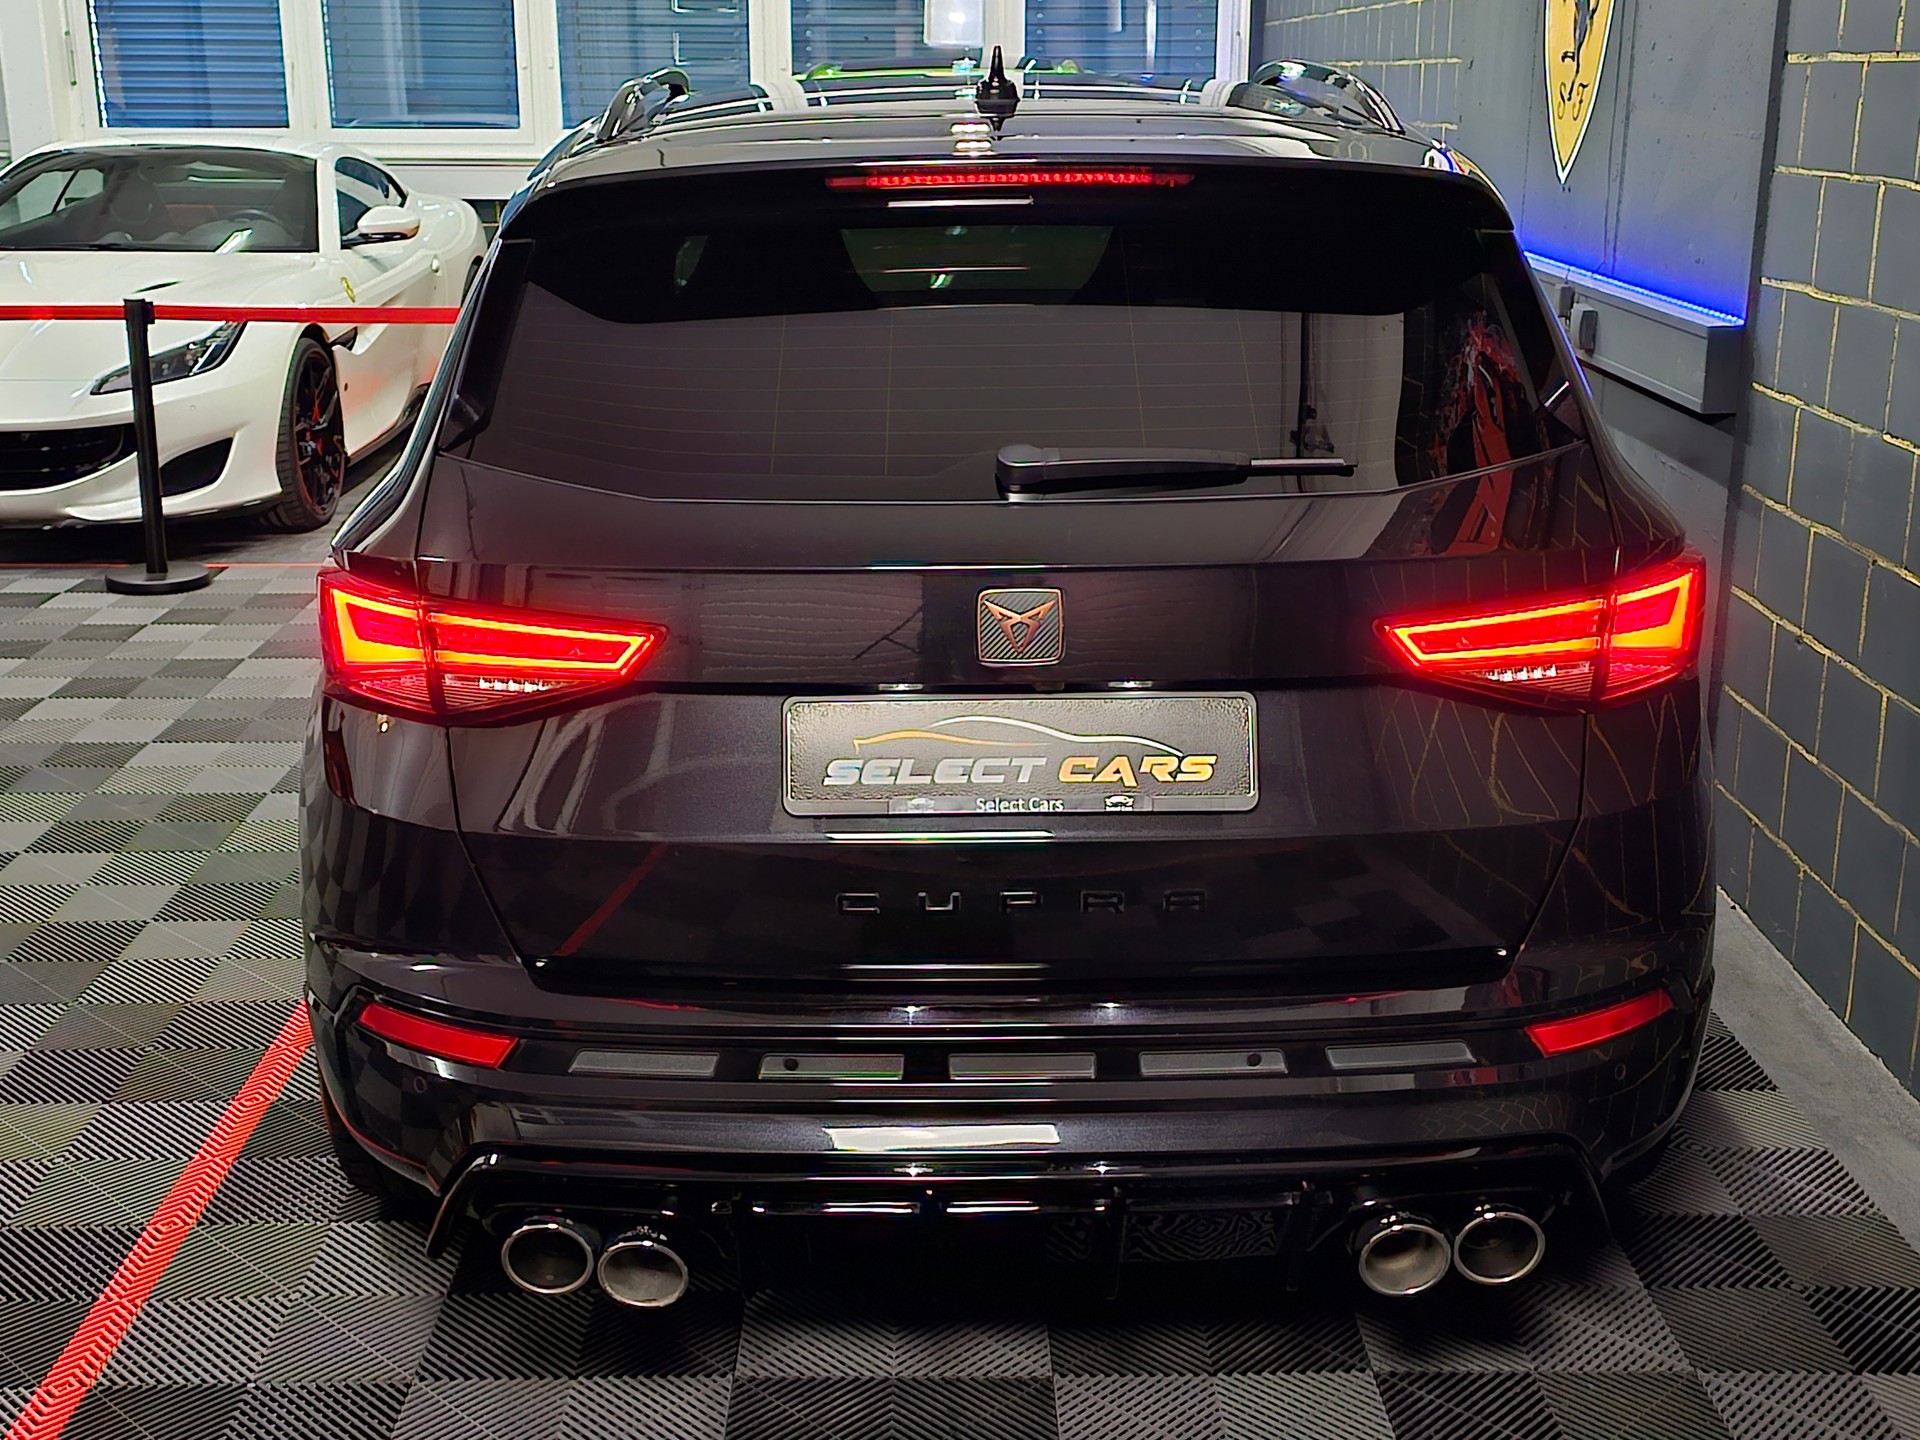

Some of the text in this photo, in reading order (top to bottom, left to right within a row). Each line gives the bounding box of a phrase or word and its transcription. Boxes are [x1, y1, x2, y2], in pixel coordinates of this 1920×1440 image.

[823, 755, 1219, 787] SELECT CARS
[975, 796, 1065, 812] Select Cars
[835, 889, 1207, 914] CUPRA
